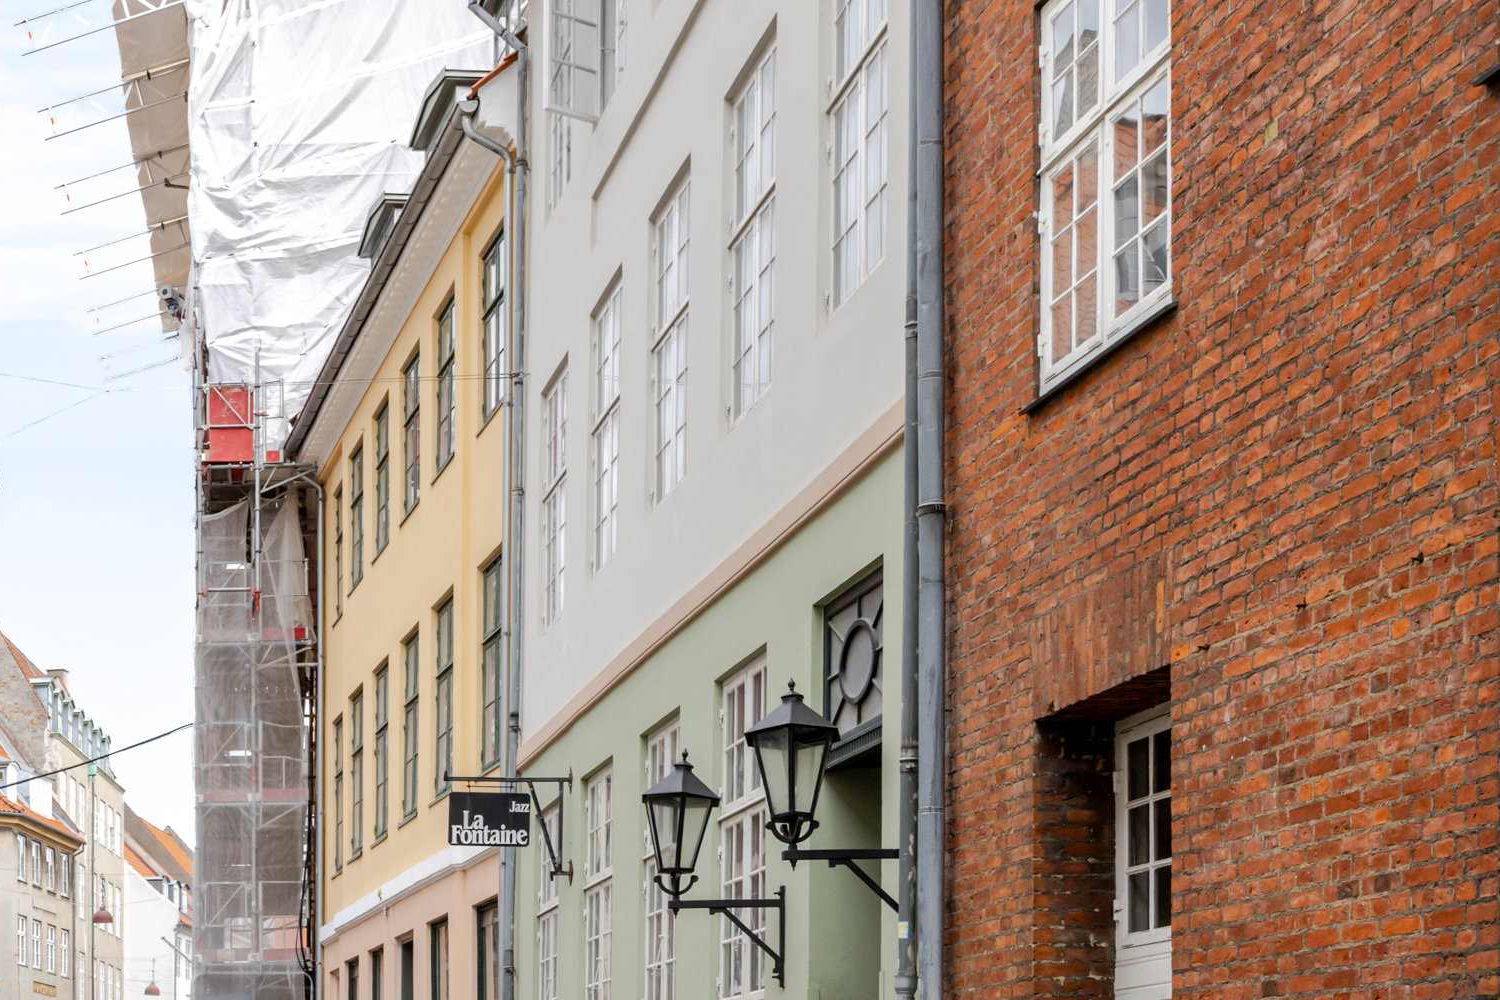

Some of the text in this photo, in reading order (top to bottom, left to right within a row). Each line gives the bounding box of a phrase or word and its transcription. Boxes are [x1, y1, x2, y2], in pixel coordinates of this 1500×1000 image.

[509, 801, 530, 813] Jazz
[462, 810, 484, 829] La
[451, 824, 528, 845] Fontaine
